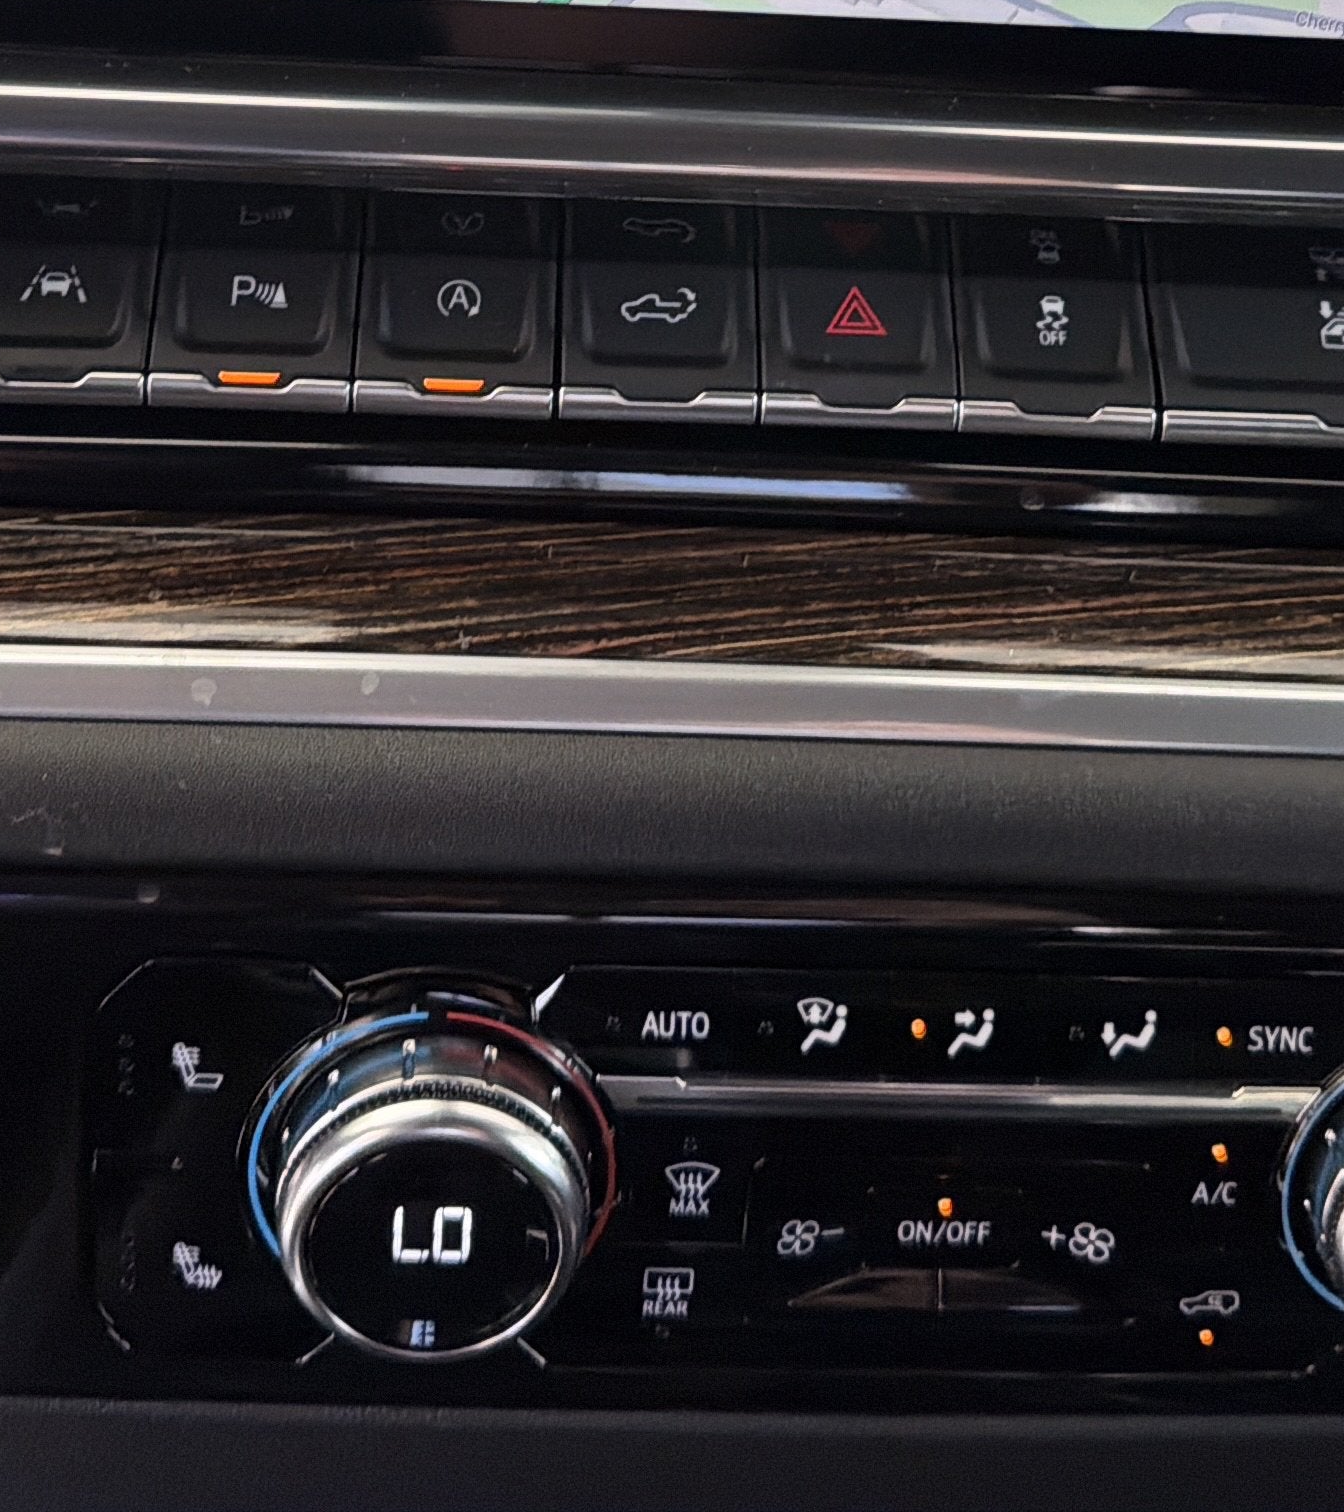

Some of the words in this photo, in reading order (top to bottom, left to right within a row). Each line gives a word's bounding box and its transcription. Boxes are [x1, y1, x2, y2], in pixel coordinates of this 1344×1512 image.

[231, 275, 257, 307] P
[1039, 330, 1068, 348] OFF
[641, 1010, 711, 1041] AUTO
[1247, 1025, 1315, 1055] SYNC
[668, 1197, 711, 1218] MAX
[1192, 1180, 1238, 1207] A/C
[392, 1205, 473, 1265] LO
[897, 1219, 992, 1247] ON/OFF
[642, 1299, 689, 1319] REAR
